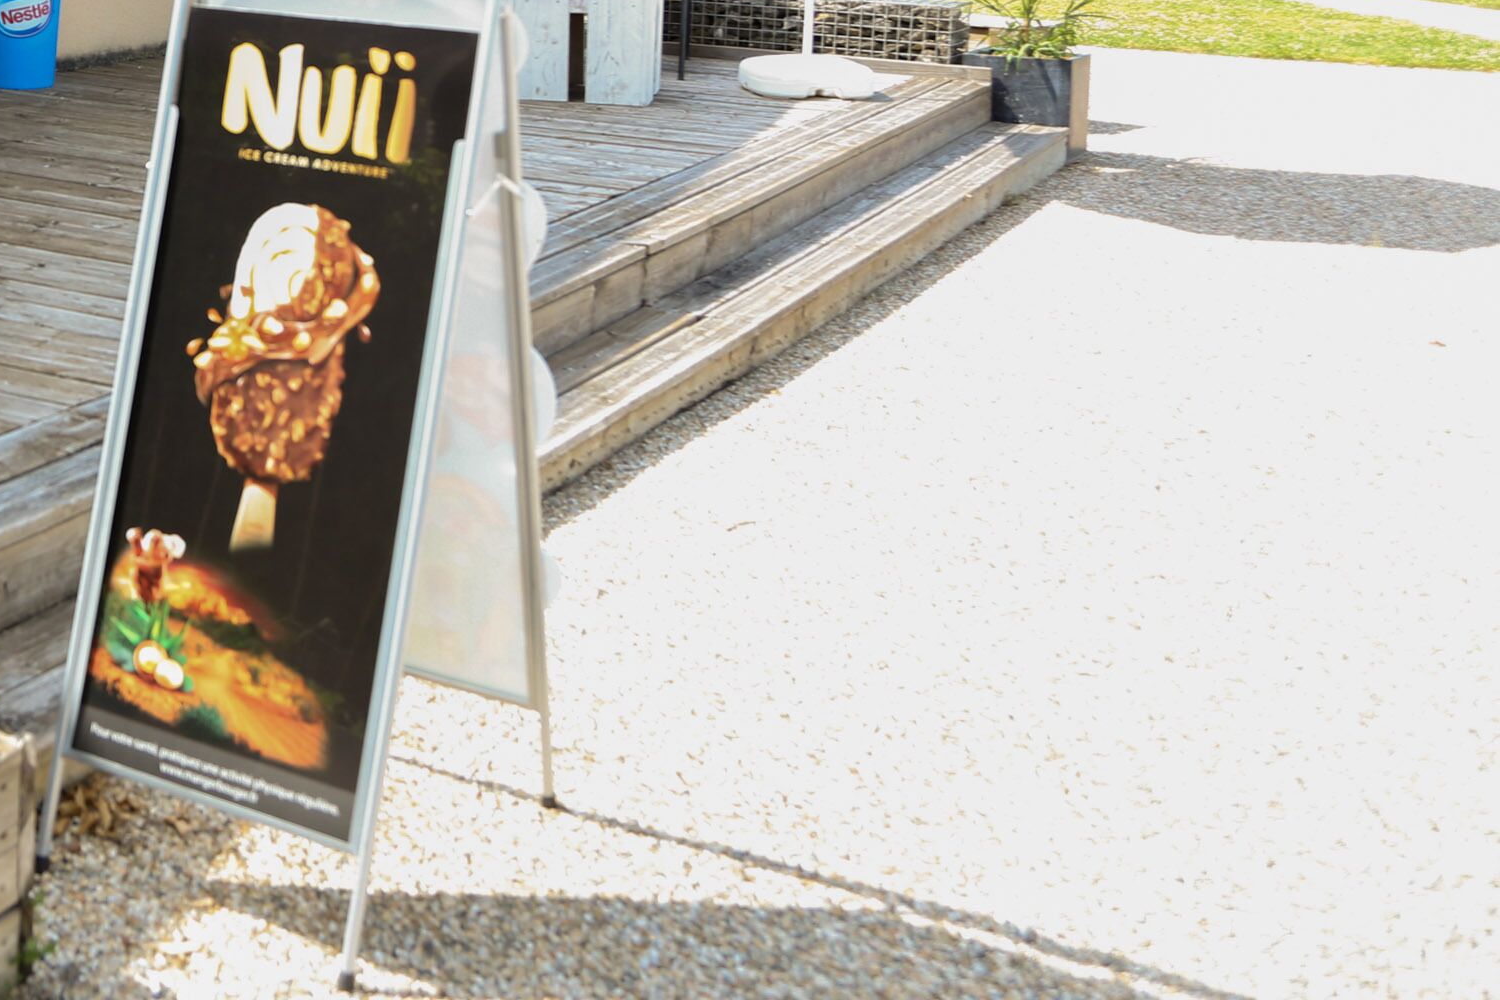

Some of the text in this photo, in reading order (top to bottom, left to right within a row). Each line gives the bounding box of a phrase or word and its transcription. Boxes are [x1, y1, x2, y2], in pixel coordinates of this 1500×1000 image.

[0, 0, 49, 25] Nestlé
[221, 42, 416, 164] Nuii
[238, 148, 388, 179] ICE CREAM ADVENTURE
